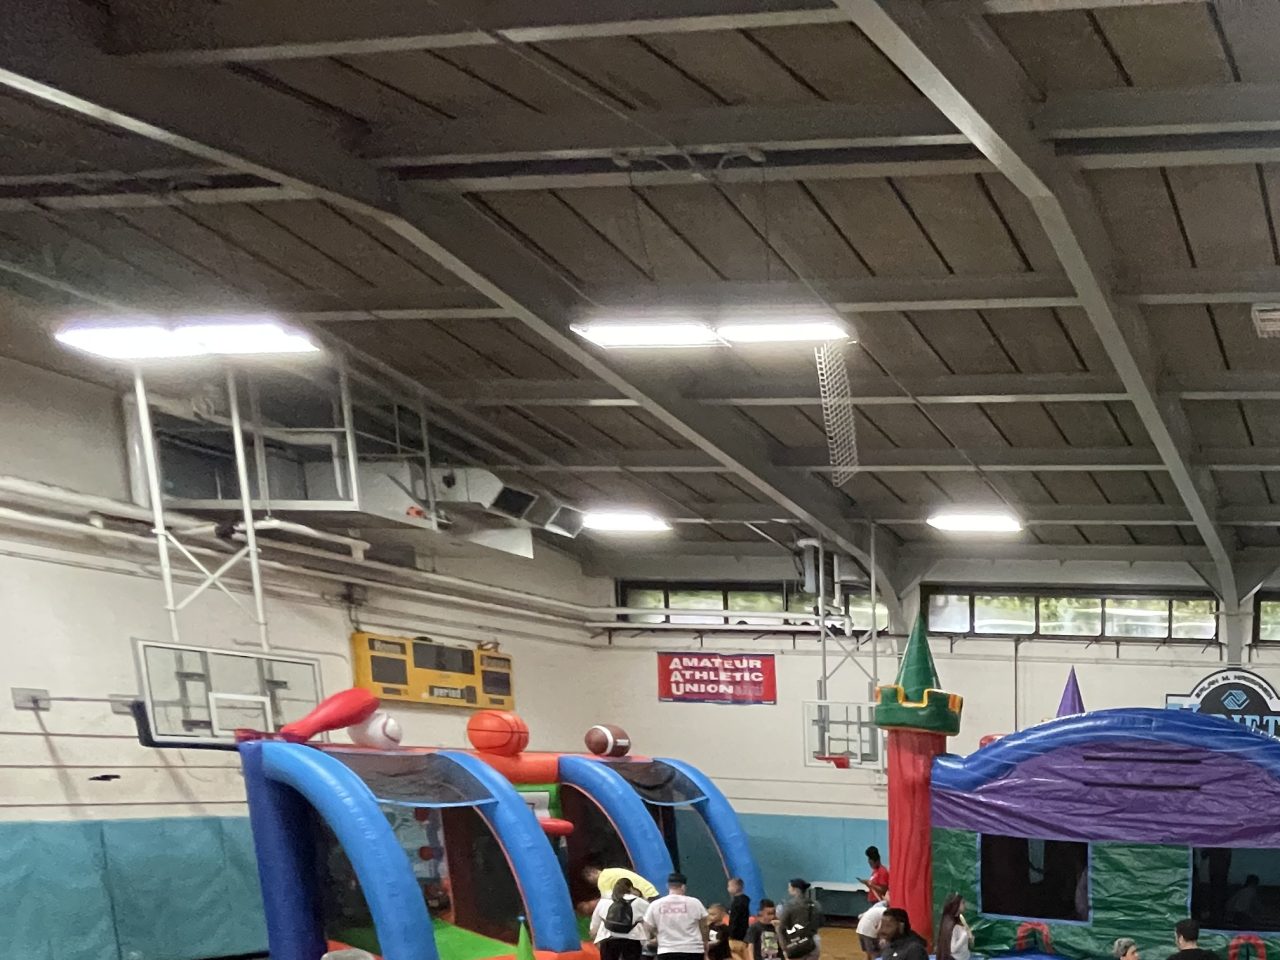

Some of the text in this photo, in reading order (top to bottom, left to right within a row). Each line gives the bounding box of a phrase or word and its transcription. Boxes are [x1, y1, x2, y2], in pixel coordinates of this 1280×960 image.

[669, 657, 763, 670] AMATEUR
[670, 670, 764, 682] ATHLETIC
[671, 683, 735, 696] UNION
